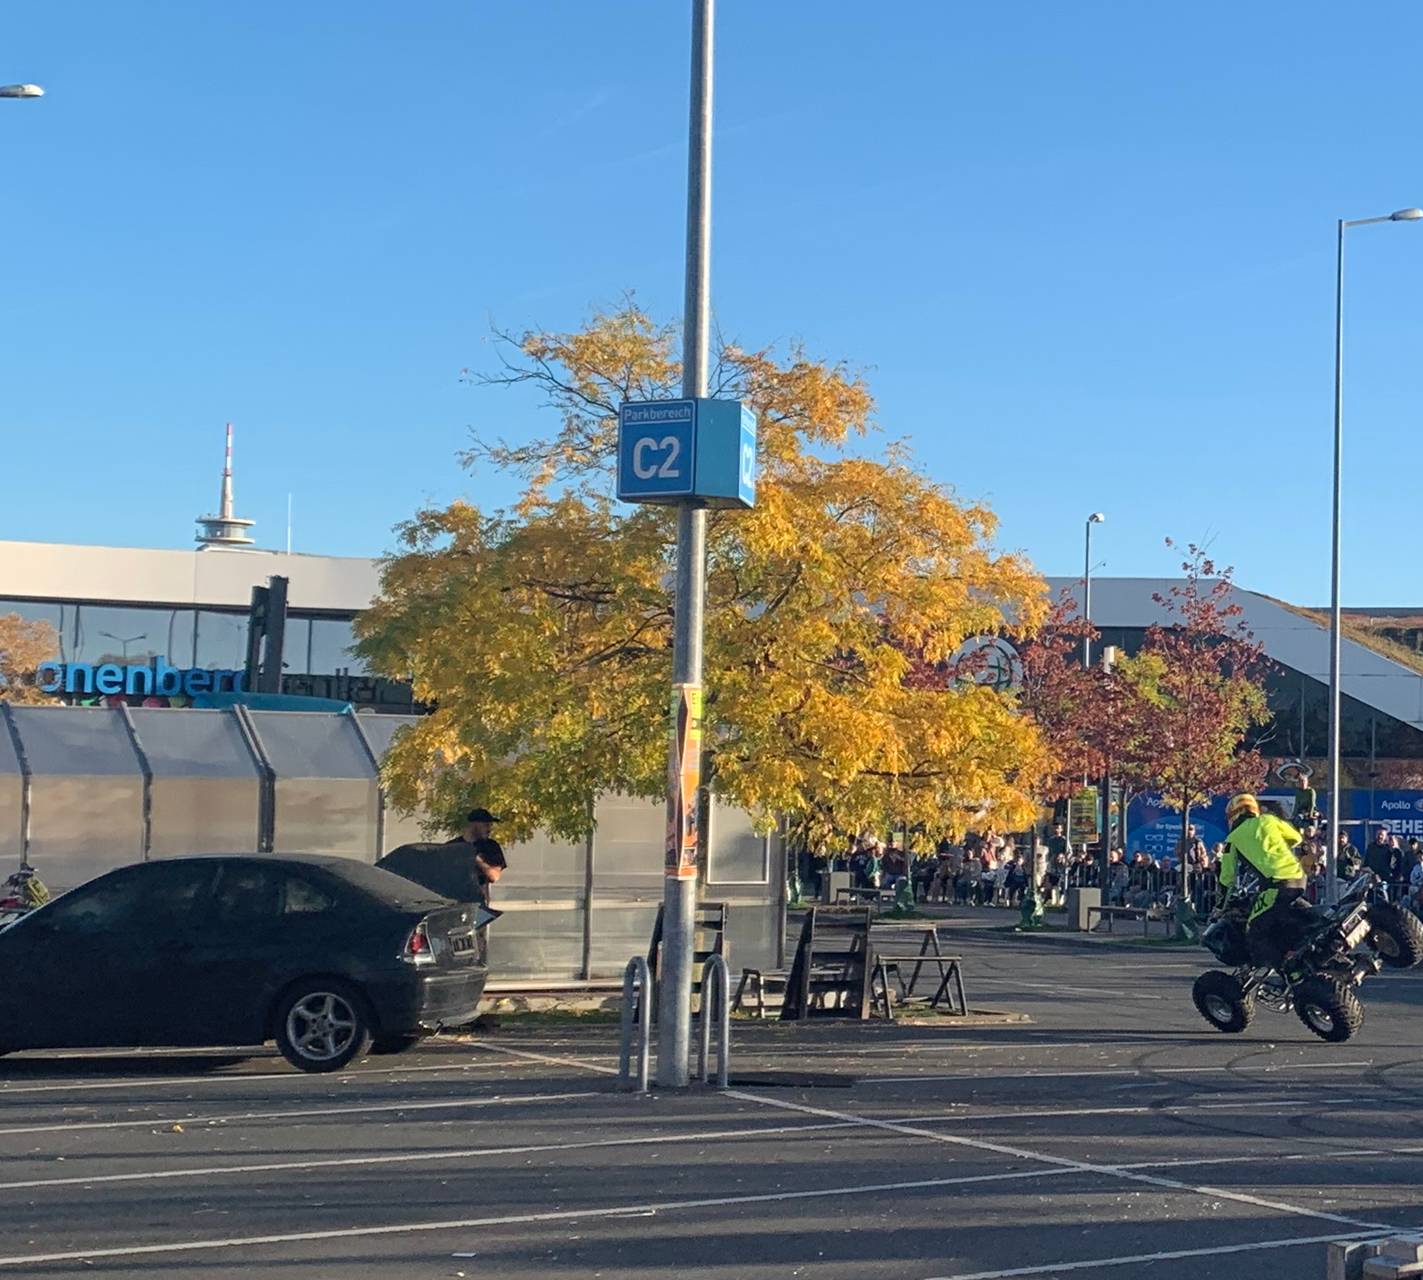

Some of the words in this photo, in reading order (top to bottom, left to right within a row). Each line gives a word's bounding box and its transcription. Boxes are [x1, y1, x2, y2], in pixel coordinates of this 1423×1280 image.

[624, 407, 692, 422] Parkbereich
[633, 436, 681, 480] C2
[1381, 800, 1411, 811] Apollo
